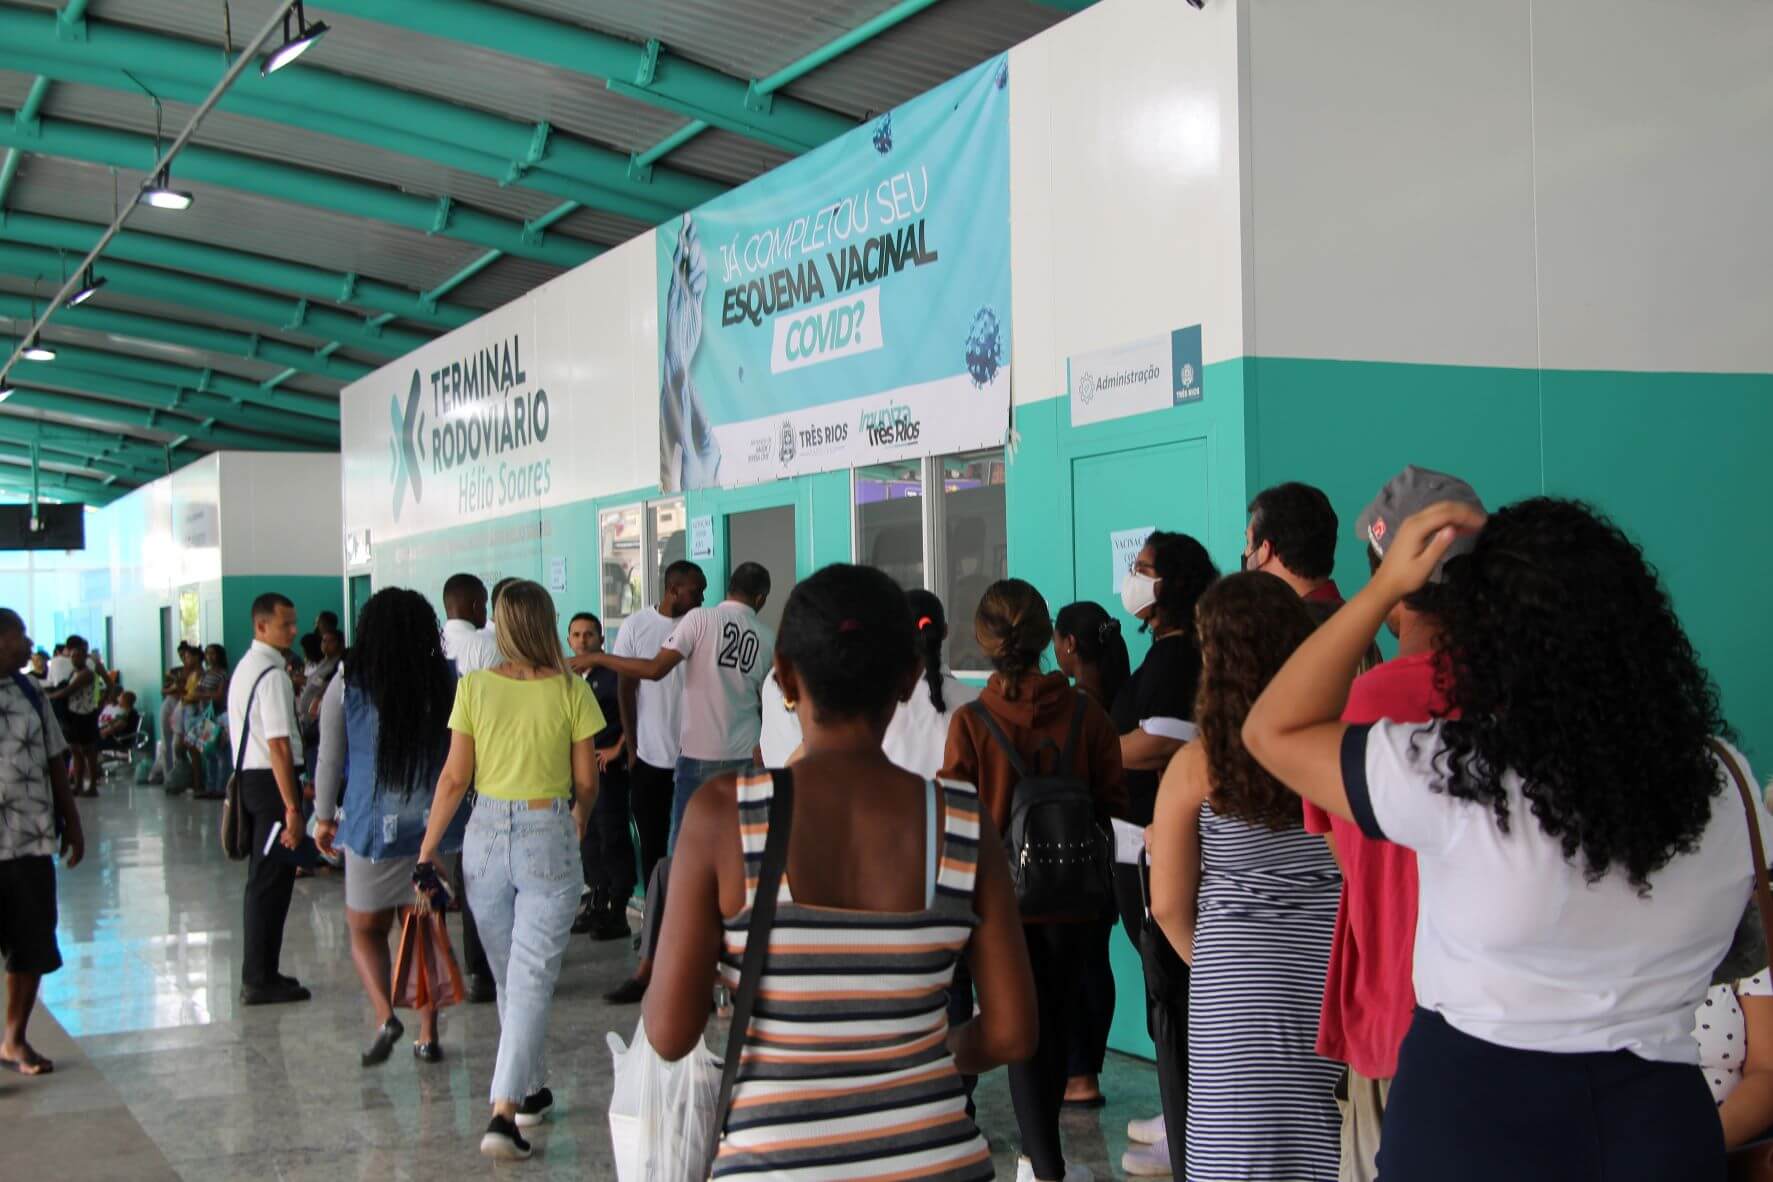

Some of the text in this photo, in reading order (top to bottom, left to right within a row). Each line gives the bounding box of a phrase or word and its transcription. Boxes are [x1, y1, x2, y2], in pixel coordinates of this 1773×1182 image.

[719, 164, 929, 283] JÁ COMPLETOU SEU
[722, 219, 938, 328] ESQUEMA VACINAL
[785, 300, 865, 362] COVID?
[430, 335, 526, 417] TERMINAL
[1096, 364, 1160, 392] Administração
[432, 387, 549, 474] RODOVIÁRIO
[800, 421, 848, 449] TRÊS RIOS
[867, 416, 920, 446] Três Rios
[458, 459, 551, 514] Hélio Soares
[718, 622, 759, 673] 20
